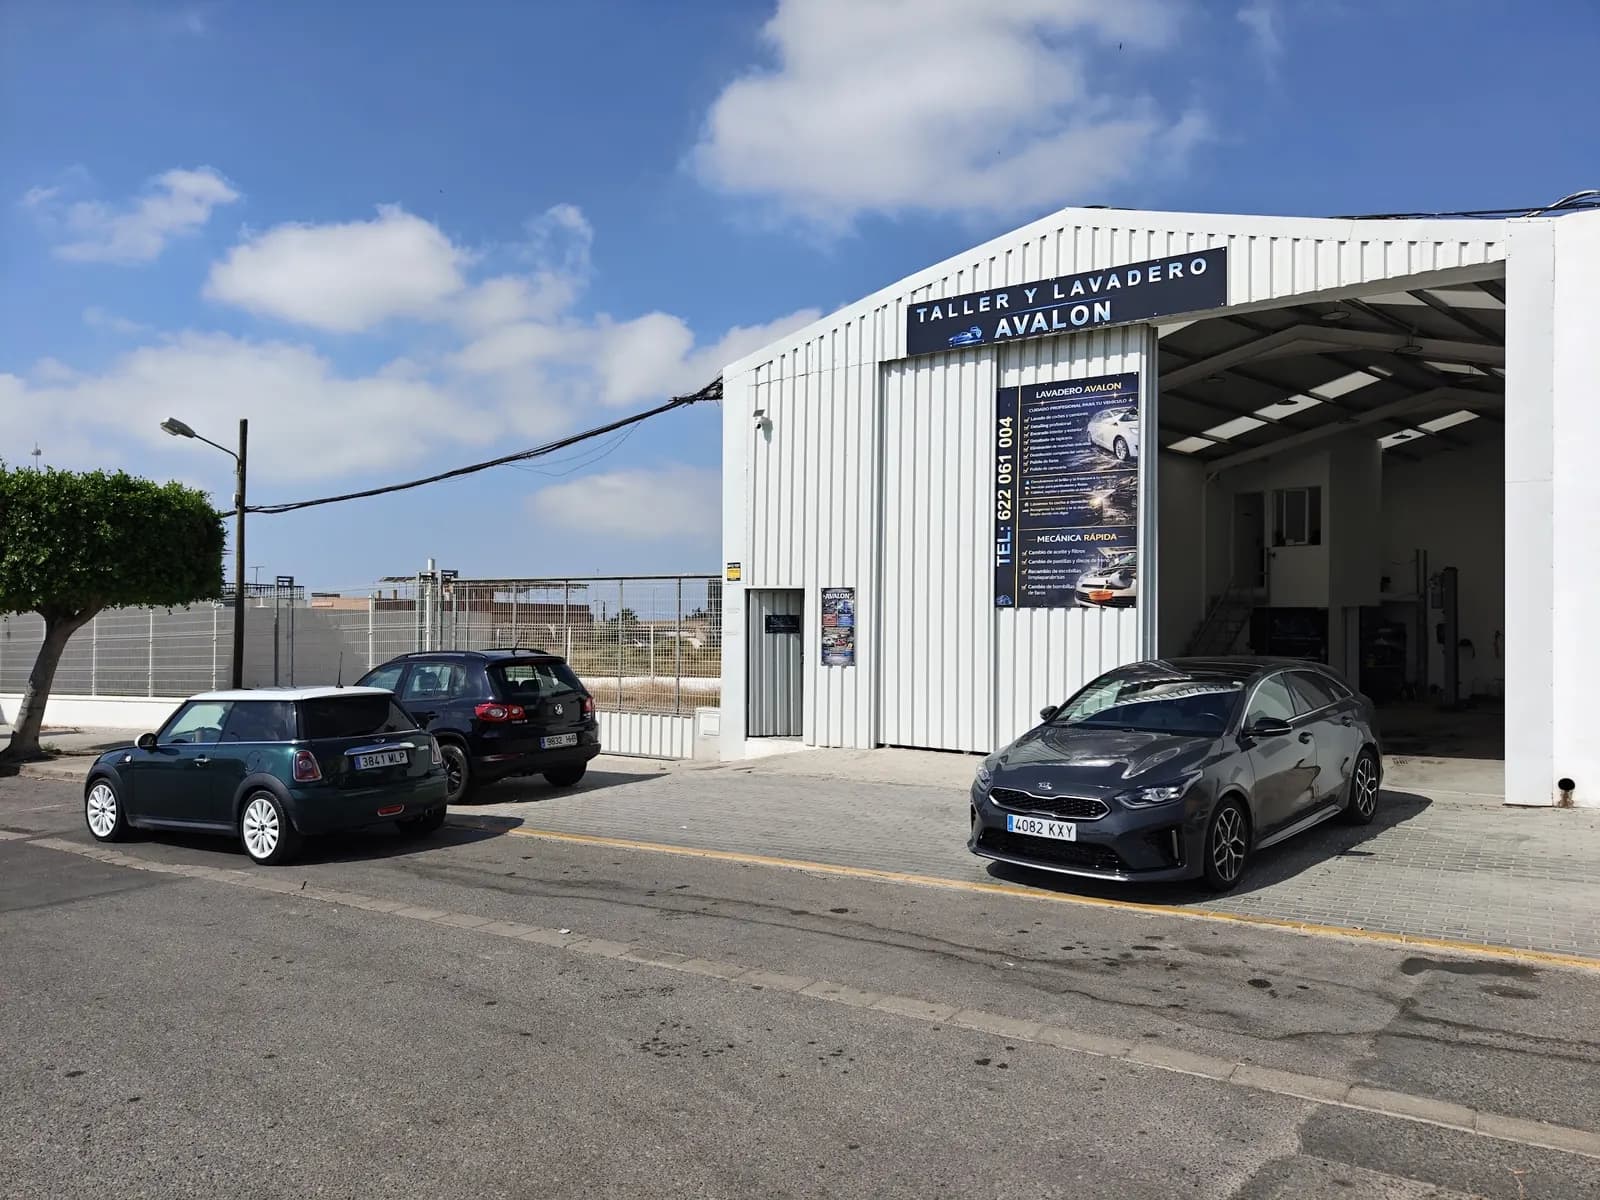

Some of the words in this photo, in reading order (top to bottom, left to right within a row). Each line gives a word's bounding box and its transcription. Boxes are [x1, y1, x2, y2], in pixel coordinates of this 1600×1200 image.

[917, 293, 1009, 322] TALLER
[1024, 287, 1038, 304] Y
[1053, 257, 1207, 299] LAVADERO
[994, 301, 1111, 339] AVALON
[1036, 386, 1083, 398] LAVADERO
[1084, 382, 1122, 393] AVALON
[999, 416, 1013, 448] 004
[998, 454, 1012, 484] 061
[997, 489, 1012, 520] 622
[996, 526, 1011, 567] TEL:
[1037, 534, 1081, 543] MECÁNICA
[1083, 533, 1117, 541] RÁPIDA
[362, 756, 385, 767] 3841
[388, 752, 405, 763] MLP
[1015, 818, 1043, 835] 4082
[1048, 823, 1073, 838] KXY
